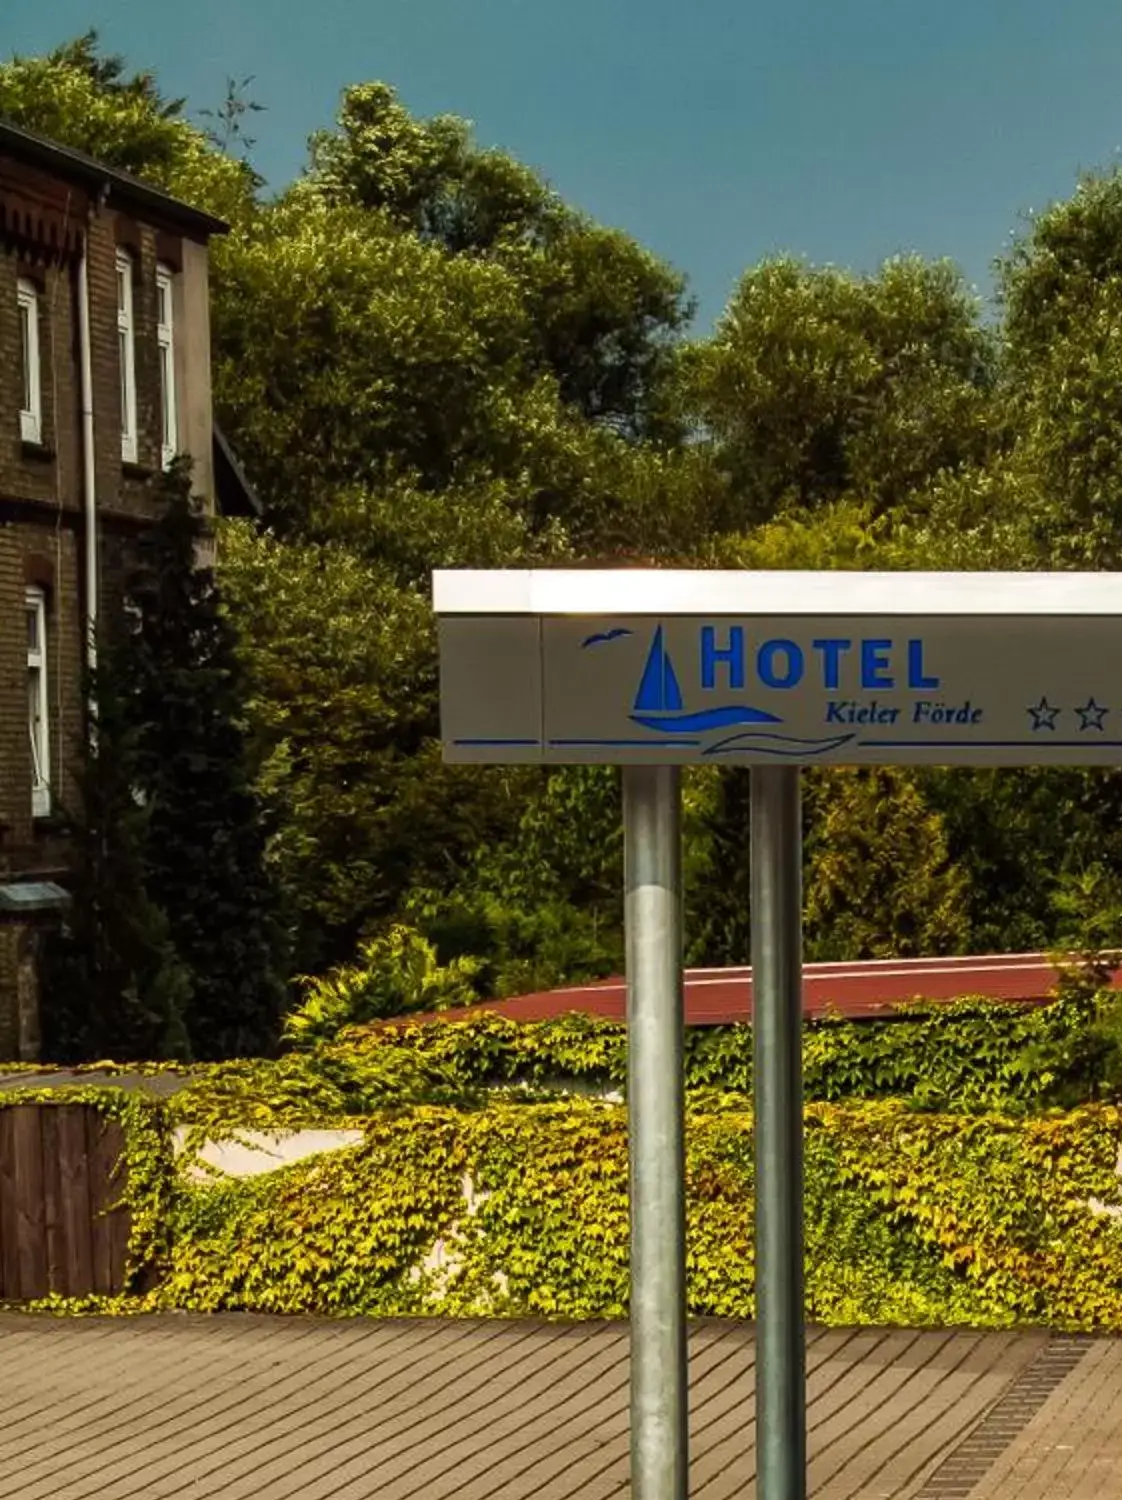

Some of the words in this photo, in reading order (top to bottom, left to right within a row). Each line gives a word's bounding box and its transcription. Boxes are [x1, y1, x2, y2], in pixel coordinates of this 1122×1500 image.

[701, 625, 940, 689] HOTEL
[825, 700, 902, 724] Kieler
[912, 700, 983, 724] Förde
